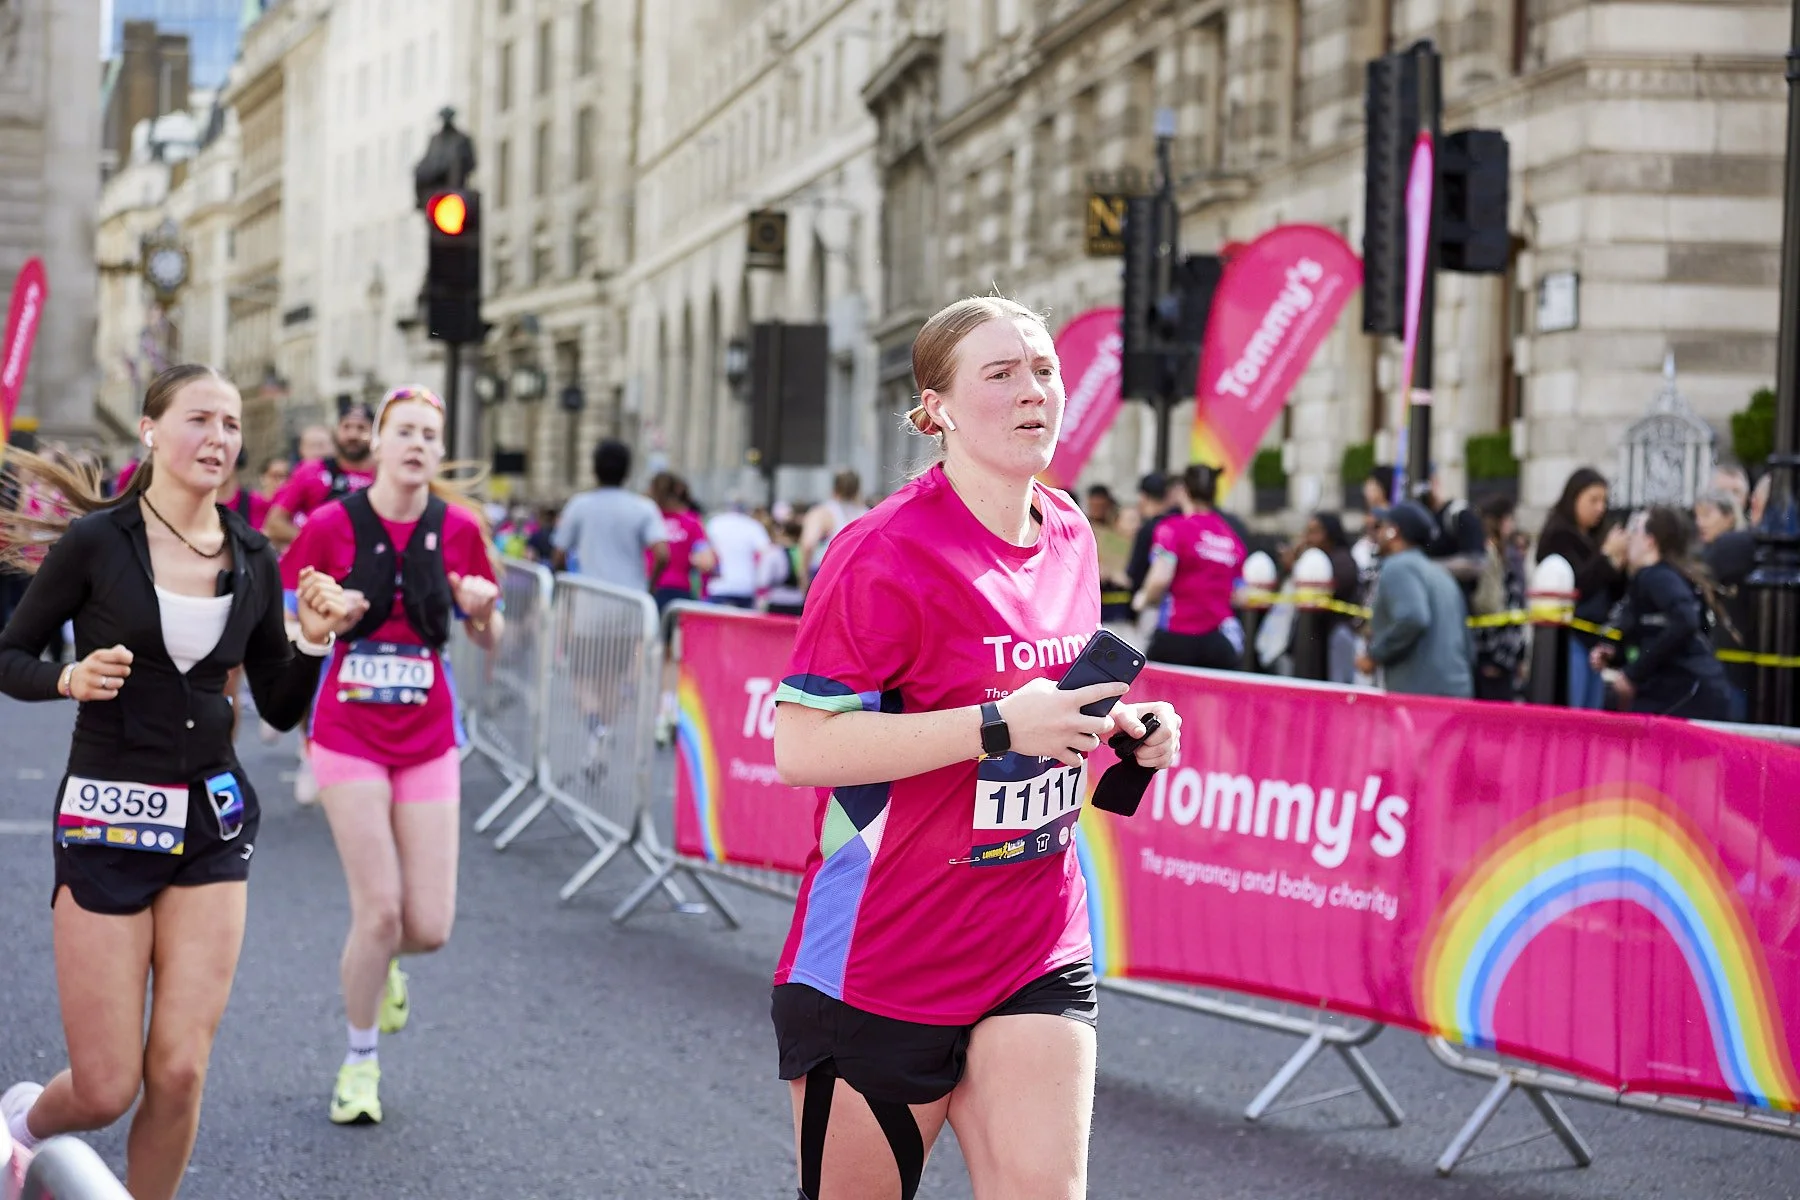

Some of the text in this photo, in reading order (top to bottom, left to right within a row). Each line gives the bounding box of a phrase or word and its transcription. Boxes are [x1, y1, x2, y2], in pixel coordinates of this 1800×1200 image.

[1214, 257, 1323, 398] Tommy's
[1058, 332, 1122, 443] ommy's
[348, 659, 426, 684] 10170
[983, 630, 1095, 673] Tomm
[742, 677, 777, 739] To
[984, 687, 1009, 699] The
[79, 783, 168, 819] 9359
[989, 766, 1082, 825] 11117
[1140, 848, 1399, 921] The pregnancy and baby charity
